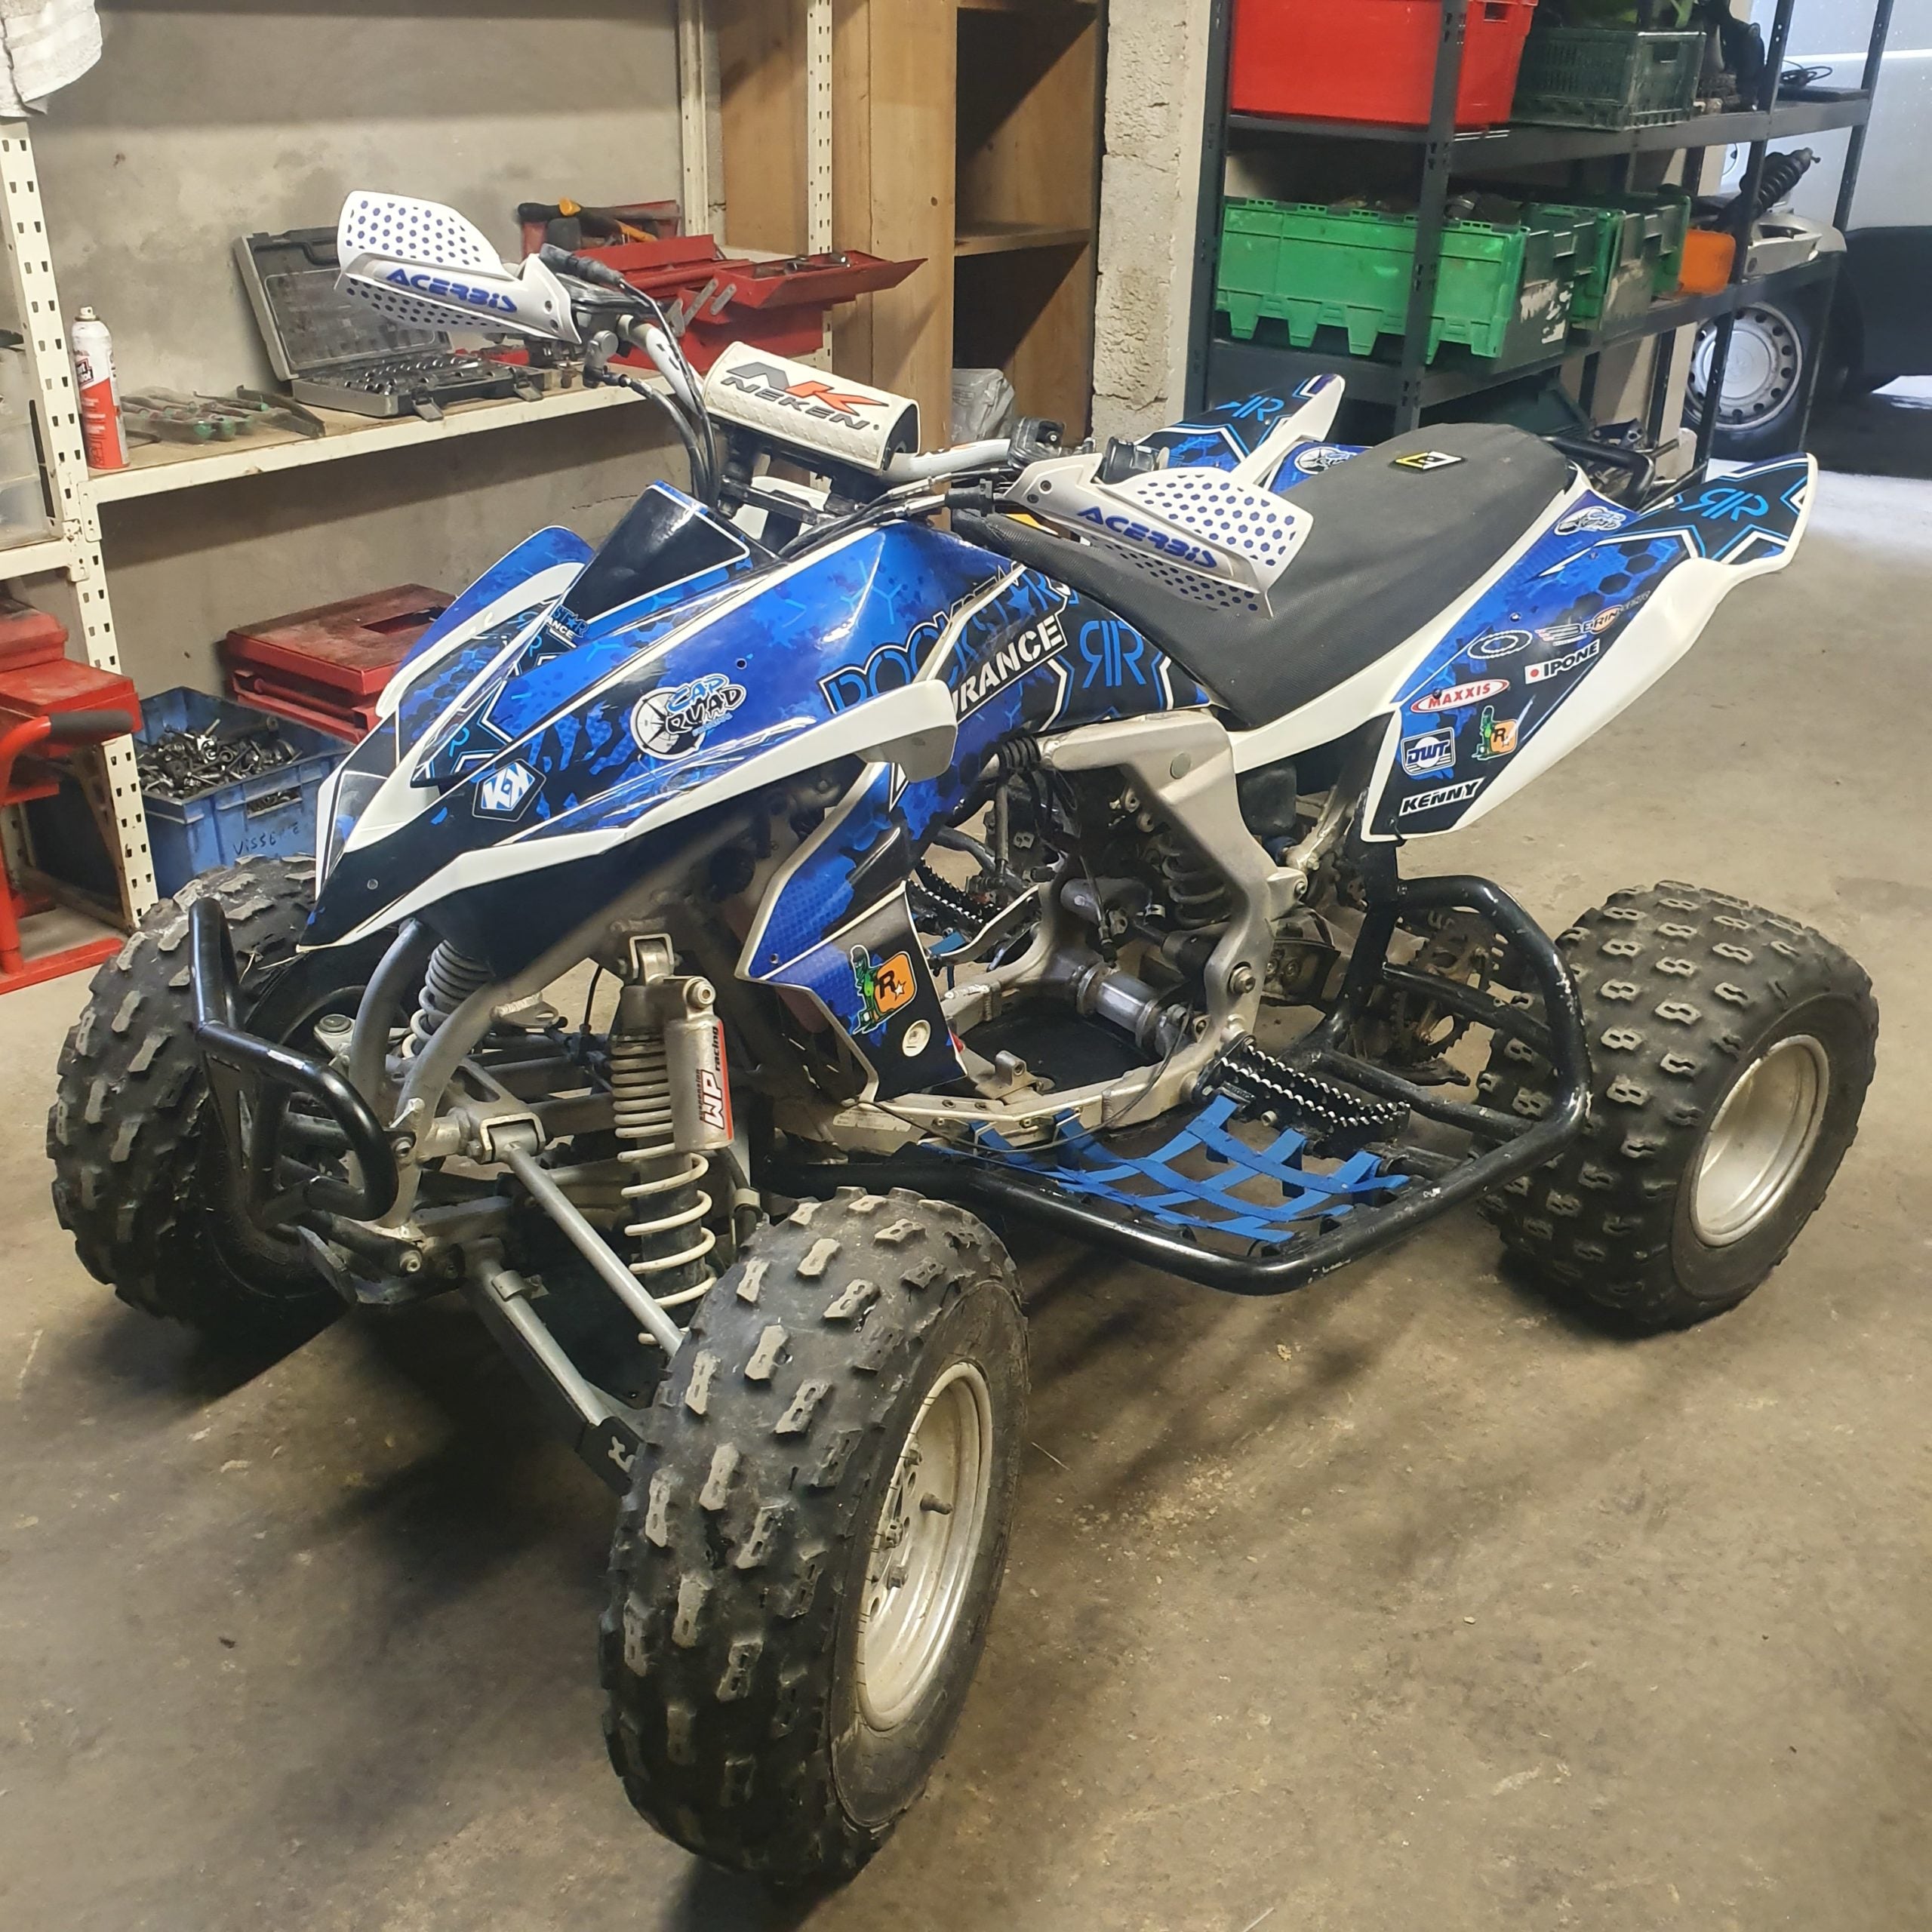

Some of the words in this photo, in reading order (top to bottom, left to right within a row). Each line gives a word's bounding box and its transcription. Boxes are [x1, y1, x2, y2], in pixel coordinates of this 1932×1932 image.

[720, 376, 870, 430] NEKEN
[1543, 643, 1599, 678] IPONE
[667, 678, 724, 713] CAP
[667, 688, 743, 734] QUAD
[1427, 683, 1492, 709] MAXXIS
[1405, 740, 1451, 765] DWT
[1401, 780, 1480, 814] KENNY
[712, 1026, 721, 1072] racing
[700, 1069, 725, 1131] WP
